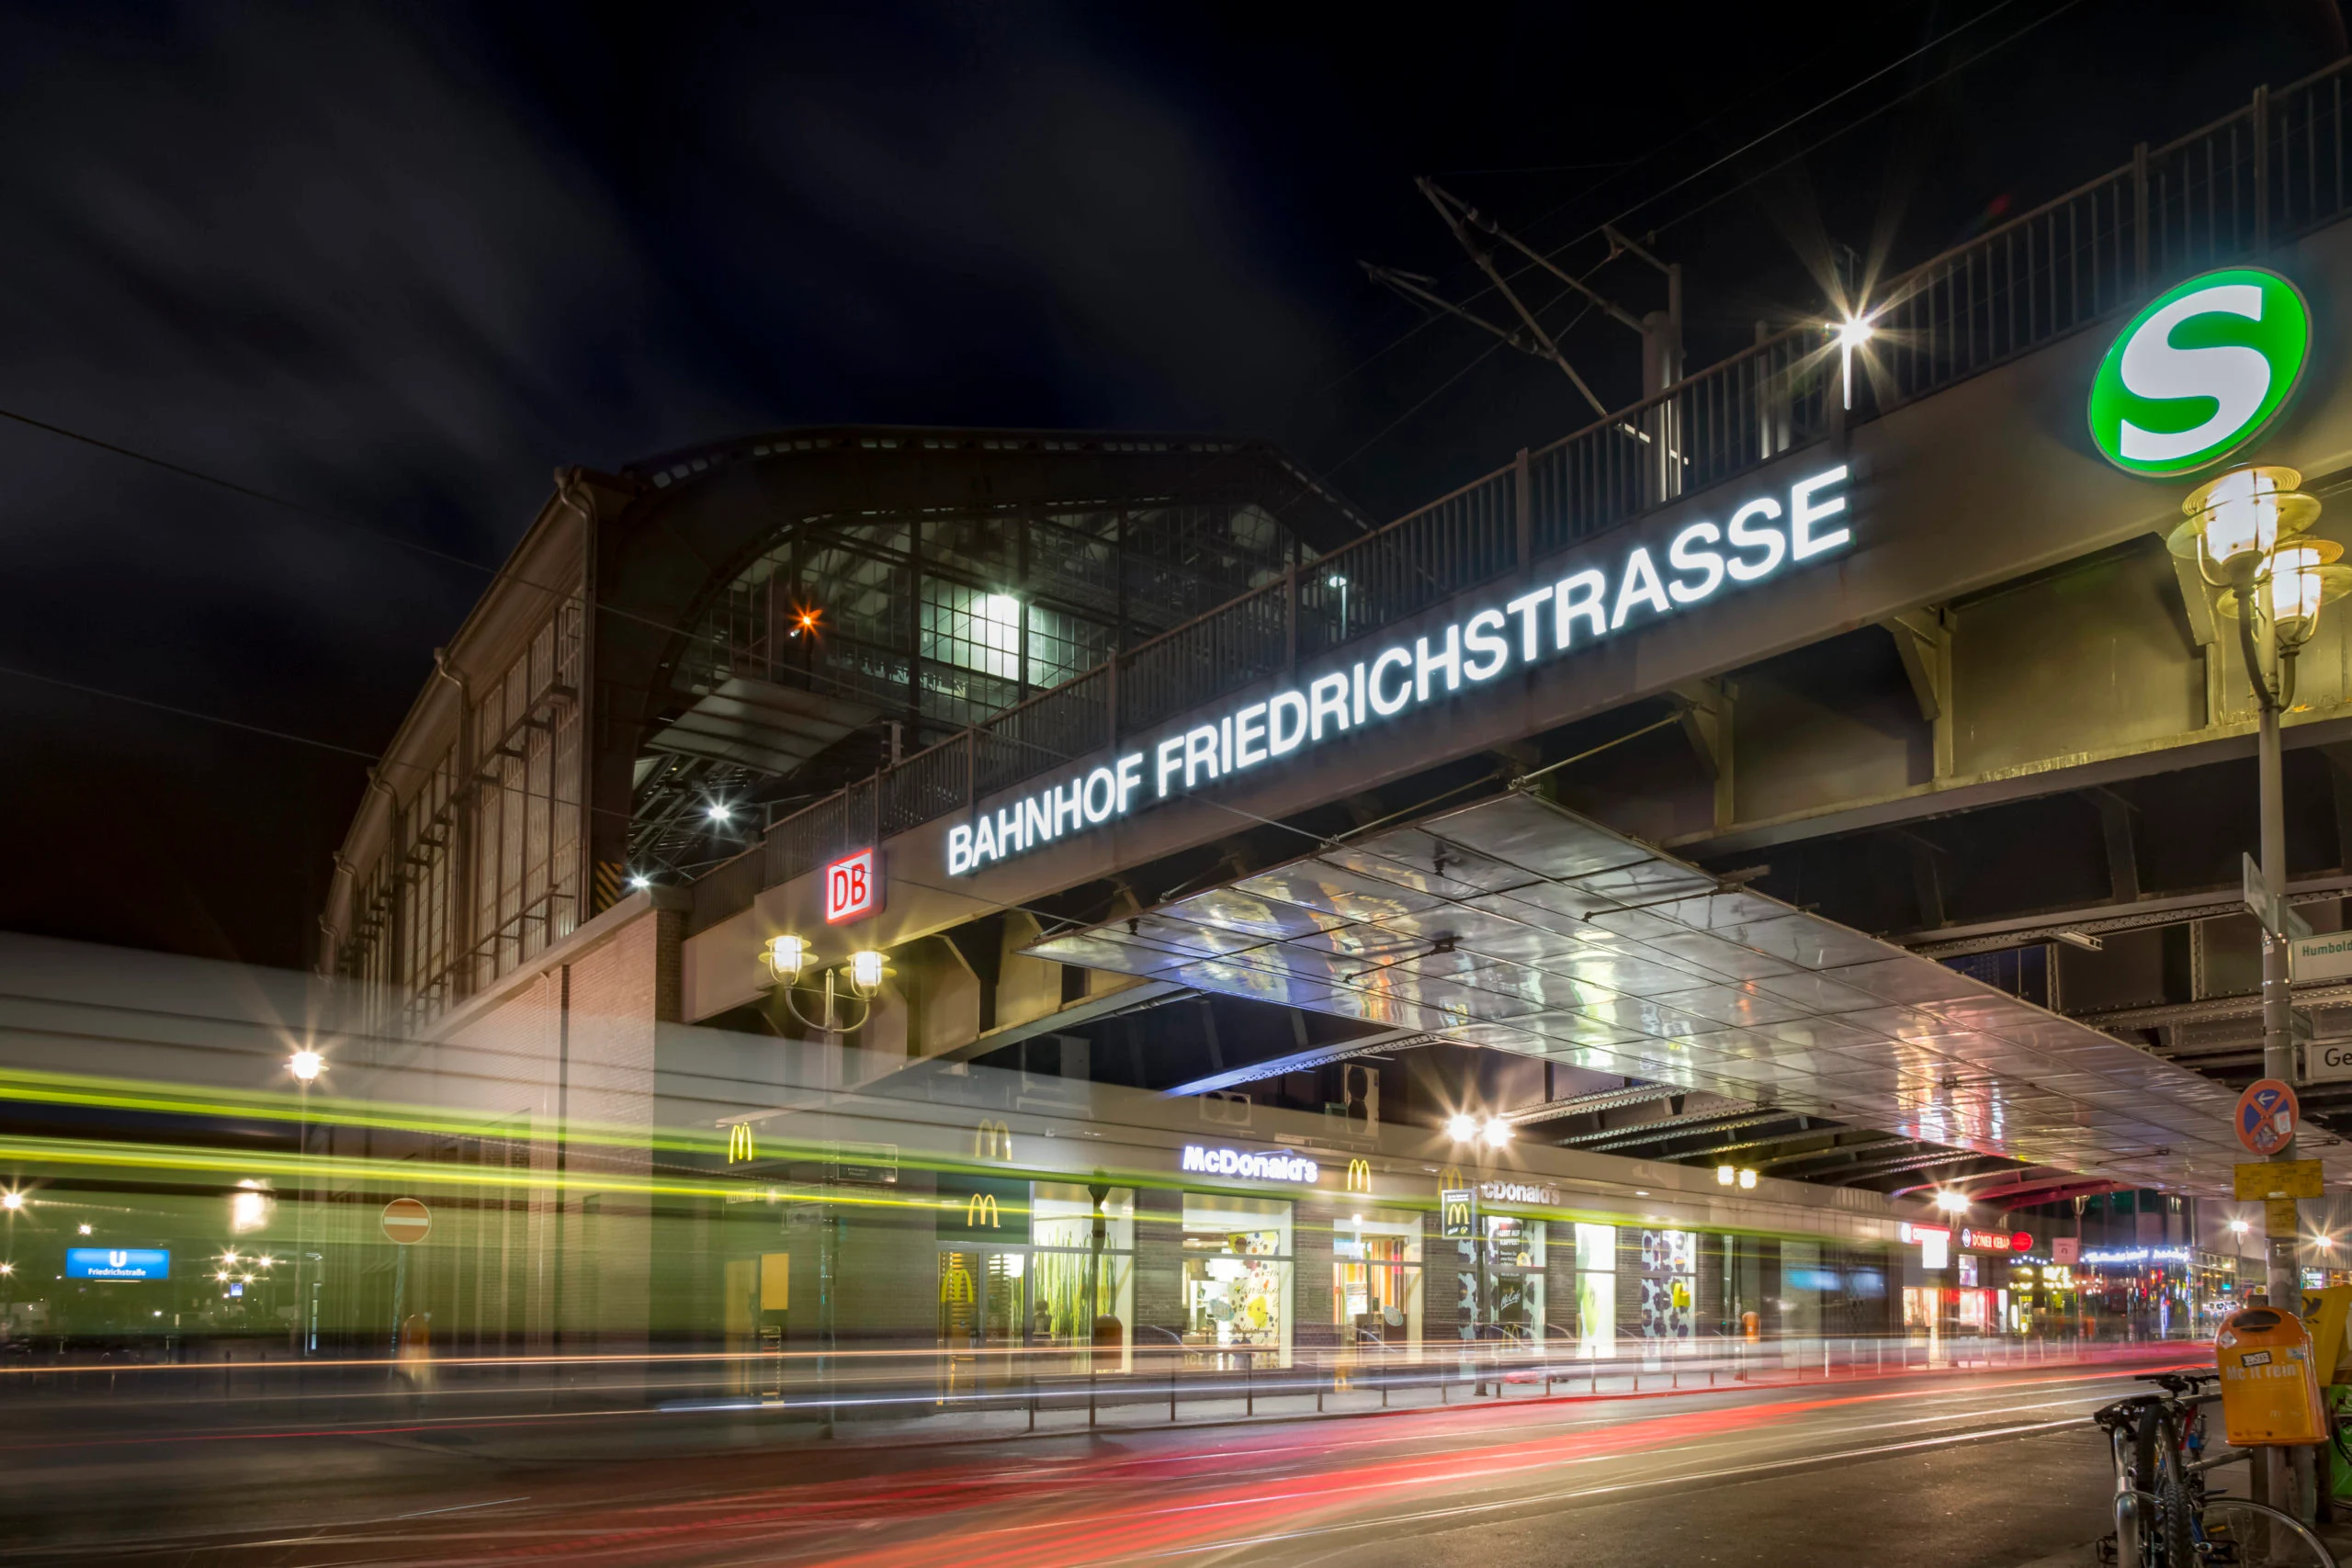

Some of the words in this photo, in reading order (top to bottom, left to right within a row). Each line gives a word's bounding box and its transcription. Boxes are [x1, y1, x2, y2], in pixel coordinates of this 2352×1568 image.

[2120, 285, 2270, 461] S
[948, 752, 1144, 875] BAHNHOF
[1159, 465, 1851, 797] FRIEDRICHSTRASSE
[833, 863, 866, 913] DB
[2325, 1048, 2352, 1067] Ge
[1182, 1146, 1318, 1183] McDonald's
[1973, 1231, 1992, 1248] DÖNER
[88, 1268, 146, 1276] Friedrichstraße
[109, 1250, 127, 1268] U
